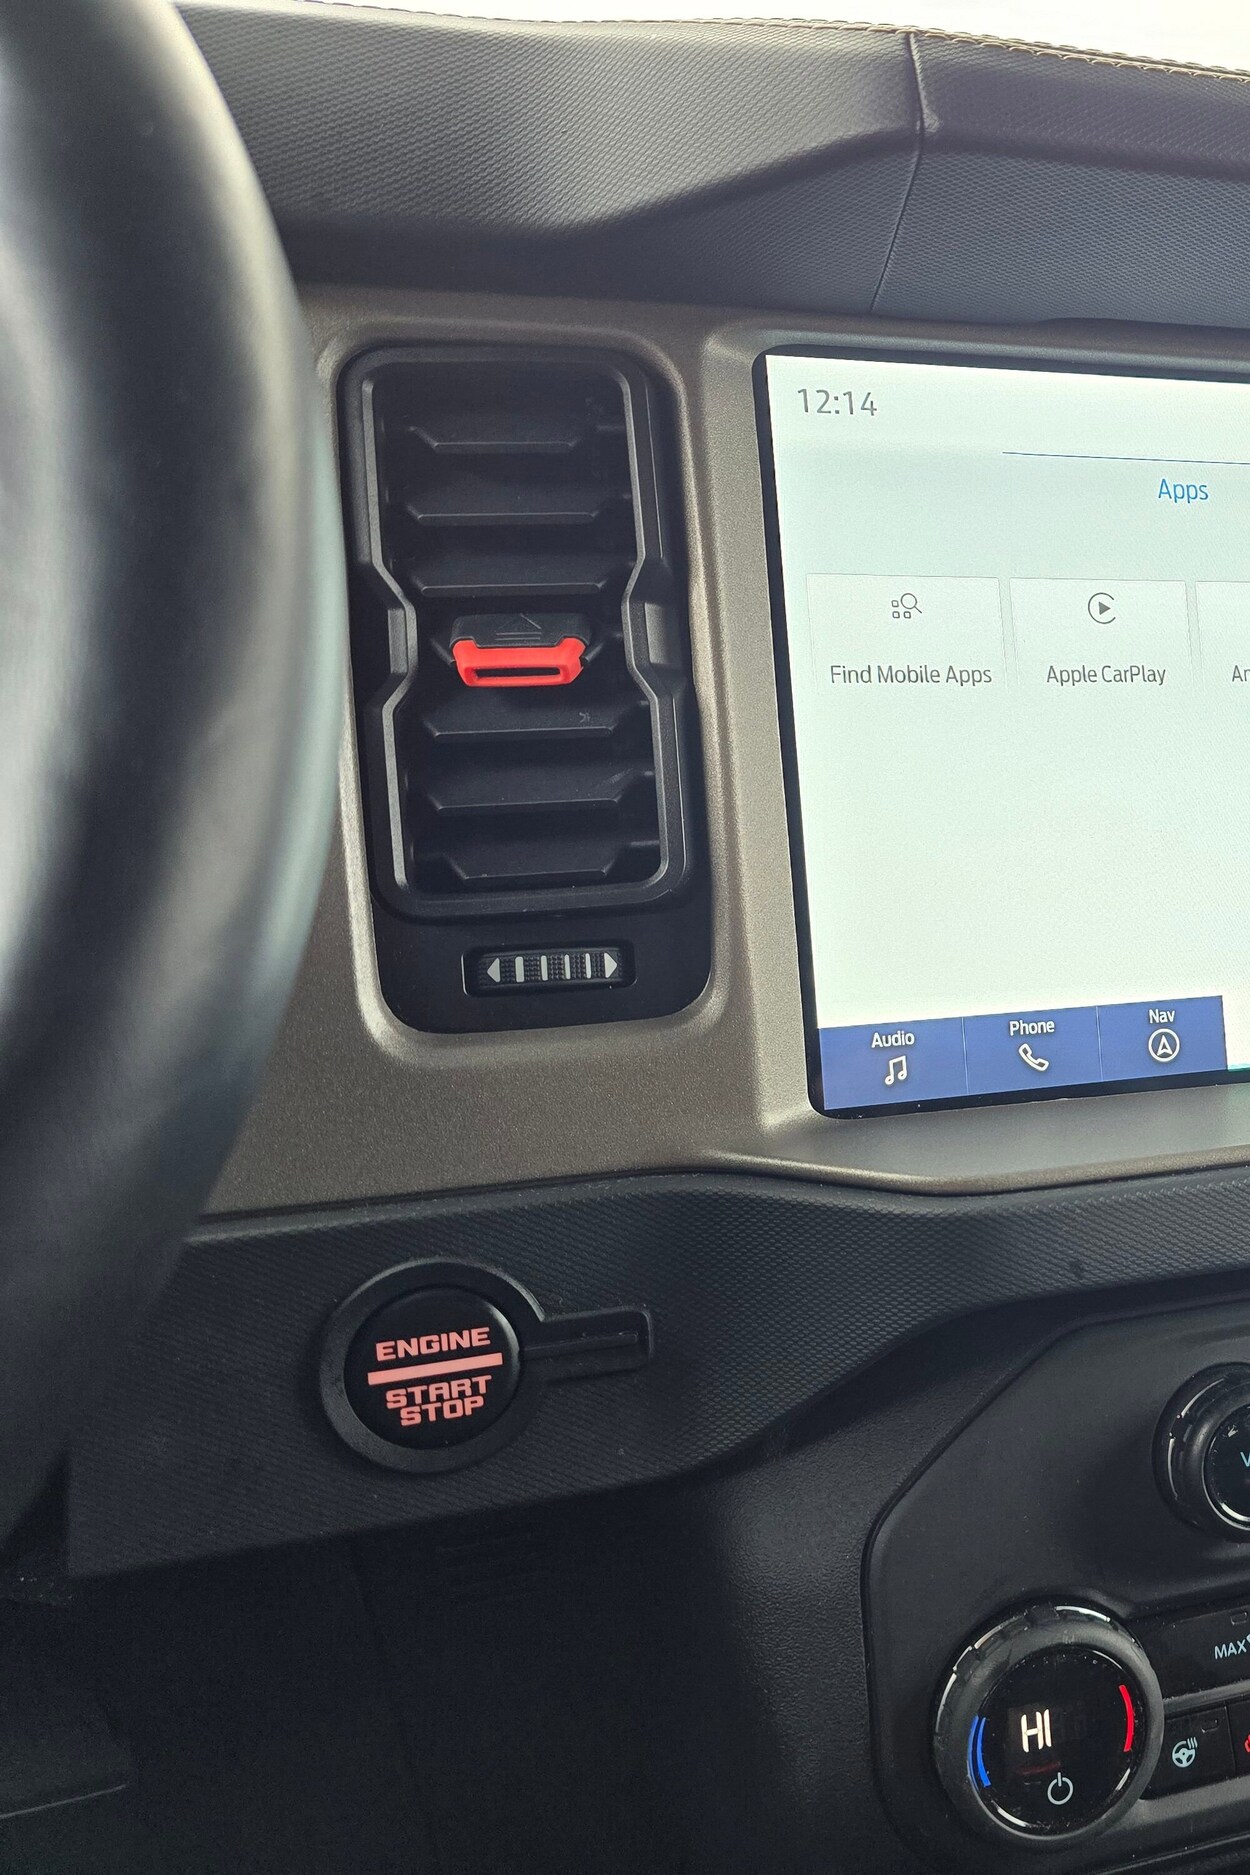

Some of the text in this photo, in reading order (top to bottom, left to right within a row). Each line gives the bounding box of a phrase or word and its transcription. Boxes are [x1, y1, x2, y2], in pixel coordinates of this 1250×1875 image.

[797, 388, 878, 417] 12:14
[1157, 478, 1210, 504] Apps
[829, 665, 993, 690] Find Mobile Apps
[1046, 665, 1167, 688] Apple CarPlay
[1008, 1019, 1056, 1037] Phone
[1148, 1008, 1177, 1025] Nav
[870, 1030, 916, 1049] Audio
[375, 1326, 491, 1362] ENGINE
[385, 1374, 493, 1410] START
[400, 1395, 485, 1426] STOP
[1214, 1639, 1247, 1660] MAX
[1020, 1708, 1053, 1753] HI
